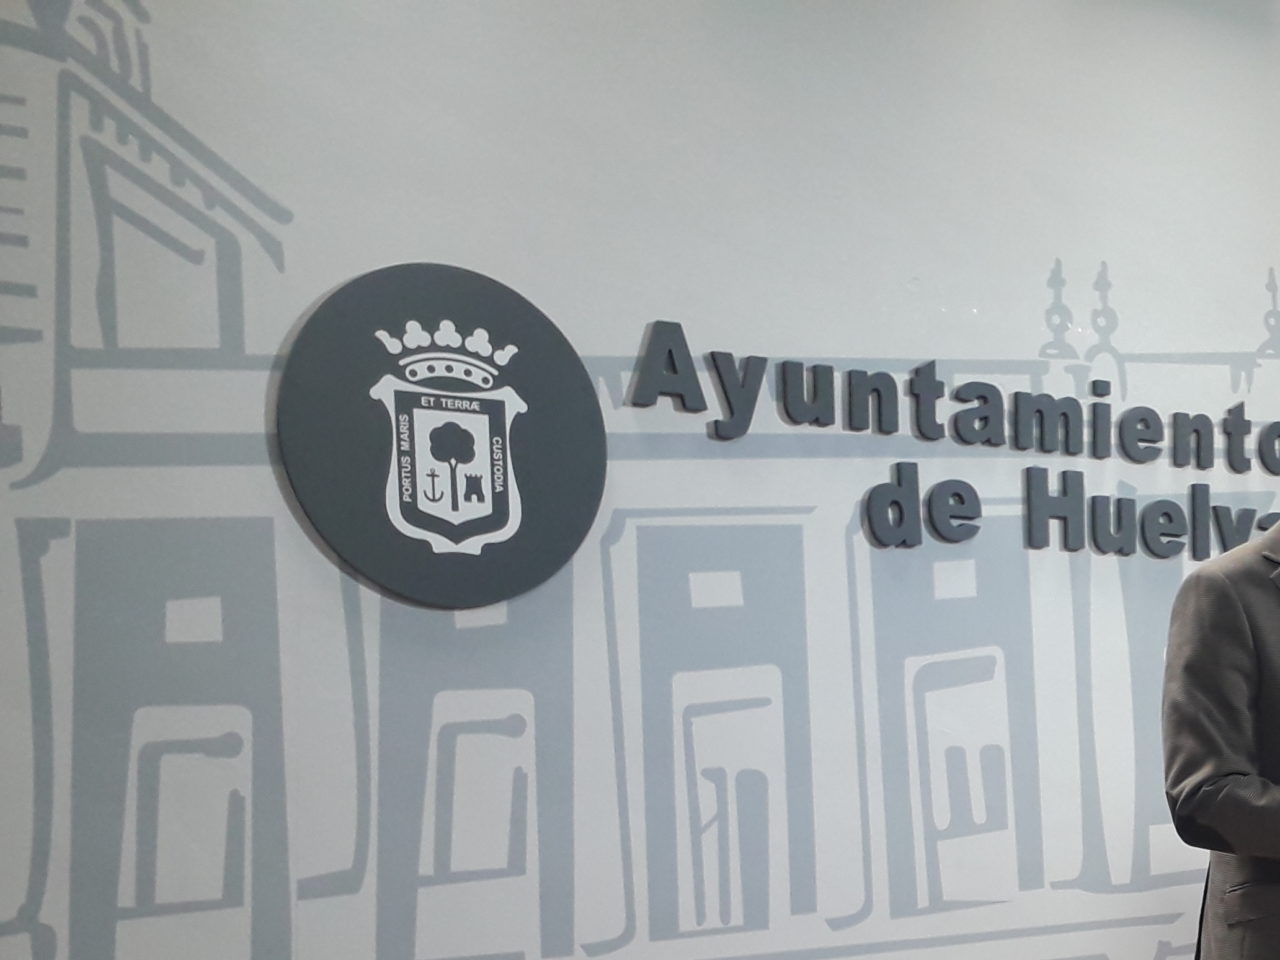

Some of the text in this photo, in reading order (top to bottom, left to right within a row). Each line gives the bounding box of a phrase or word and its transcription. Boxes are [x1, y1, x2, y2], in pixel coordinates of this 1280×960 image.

[421, 396, 435, 407] ET
[399, 414, 412, 502] PORTUS MARIS
[492, 437, 504, 493] CUSTODIA
[863, 462, 982, 549] de
